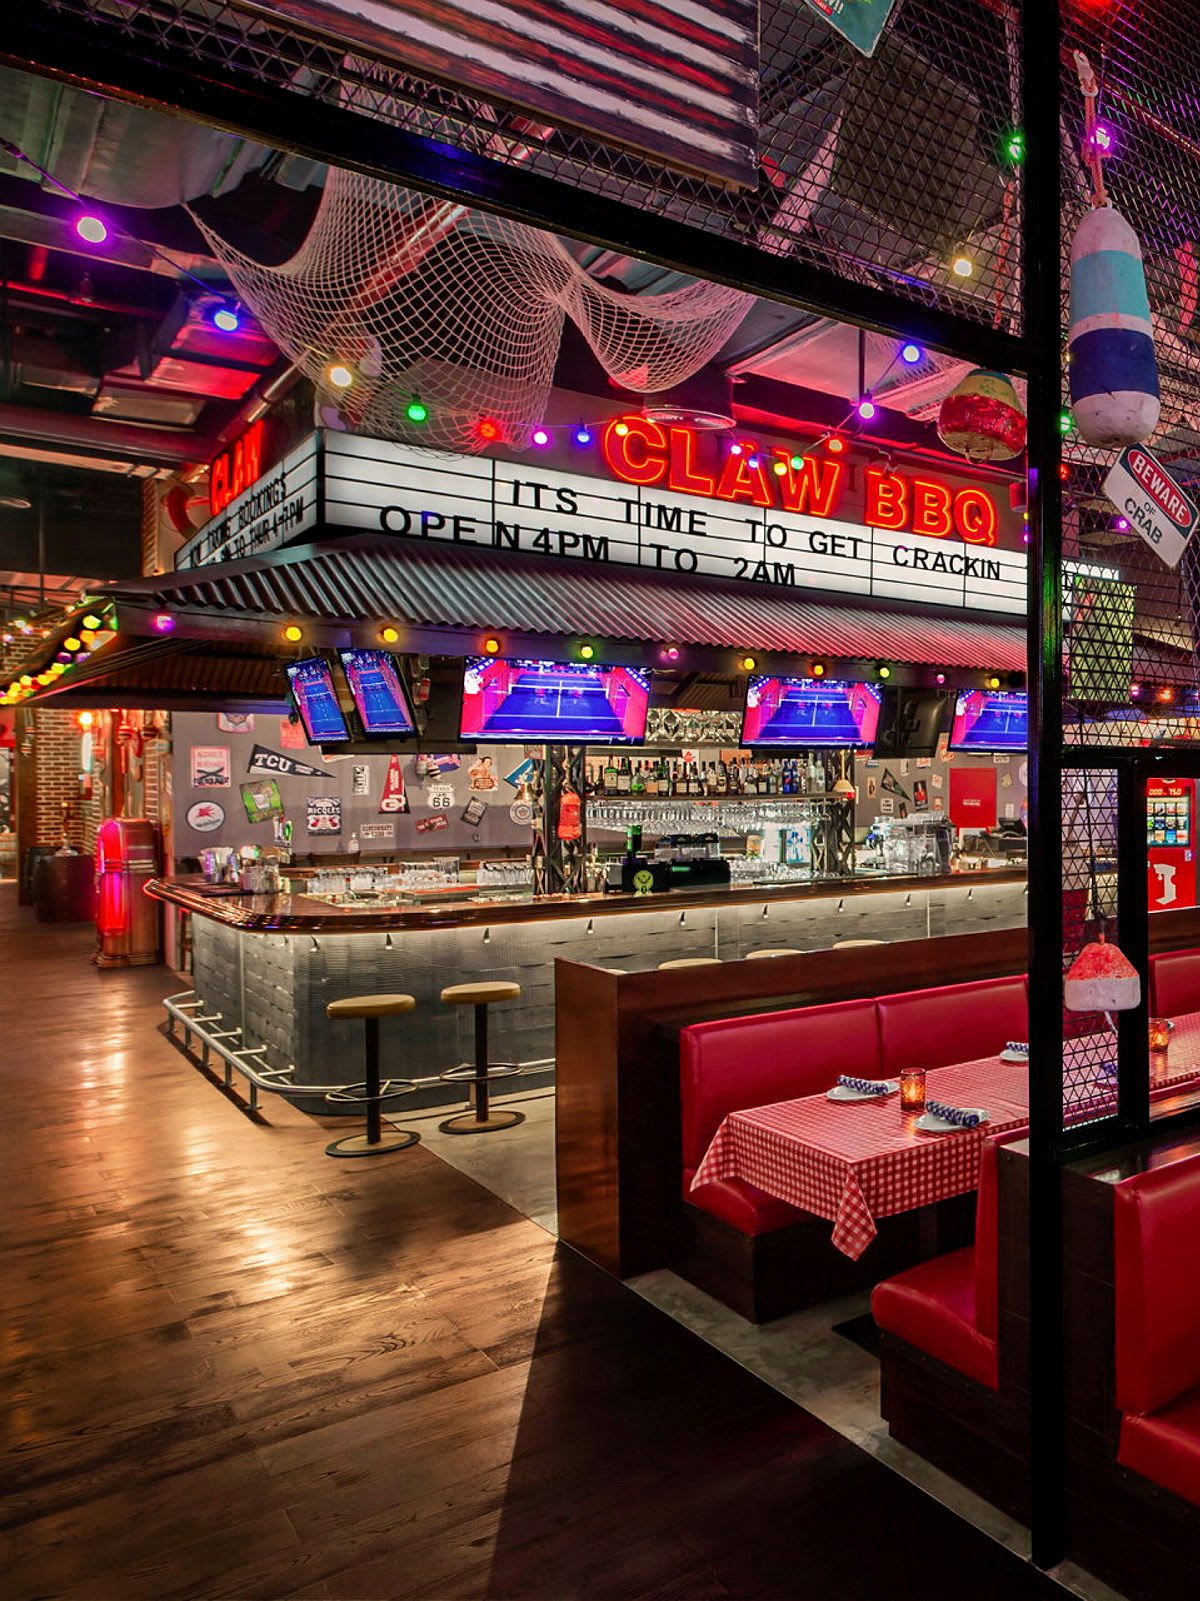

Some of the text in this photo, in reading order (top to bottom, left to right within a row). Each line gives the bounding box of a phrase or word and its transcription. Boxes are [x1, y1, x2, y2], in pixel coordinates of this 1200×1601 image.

[604, 416, 996, 547] CLAW BBQ
[1132, 454, 1187, 523] BEWARE
[513, 479, 1001, 580] ITS TIME TO GET CRACKIN
[1124, 497, 1163, 544] CRAB
[1143, 502, 1157, 515] OF
[650, 543, 698, 573] TO
[733, 557, 796, 587] 2AM
[254, 753, 292, 772] TCU
[432, 797, 451, 808] 66
